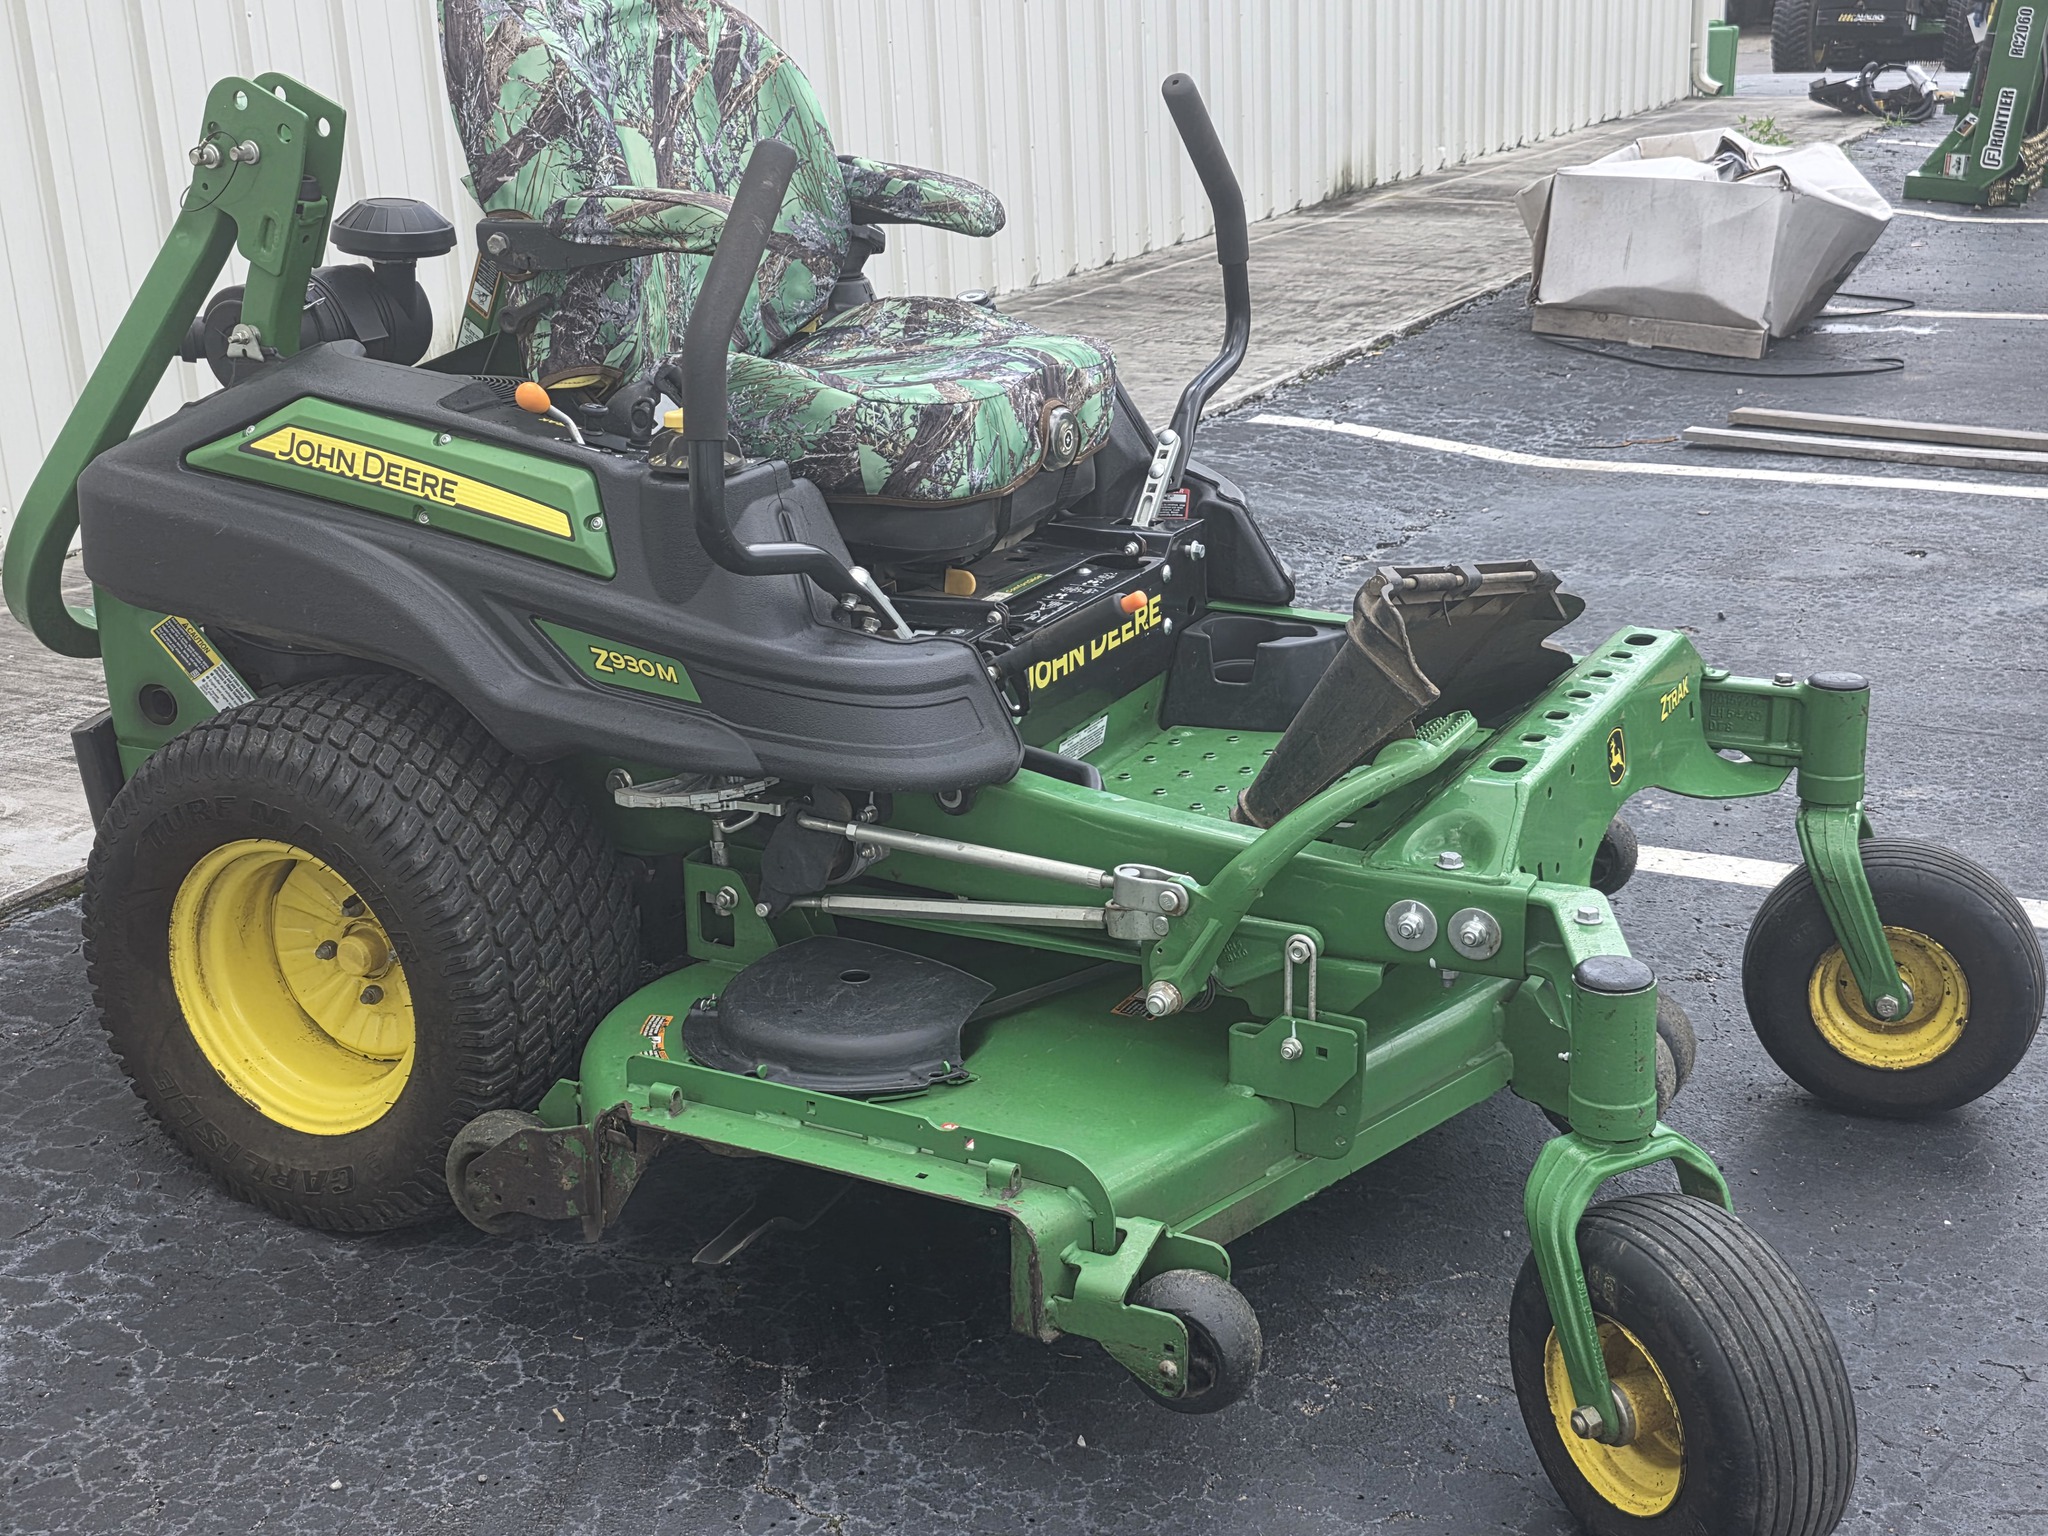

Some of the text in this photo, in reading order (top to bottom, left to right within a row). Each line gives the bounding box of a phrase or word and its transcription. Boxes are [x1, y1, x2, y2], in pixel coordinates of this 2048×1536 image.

[2010, 8, 2033, 56] RC2060
[1981, 89, 2015, 167] FRONTIER
[278, 432, 459, 502] JOHN DEERE
[187, 627, 211, 654] CAUTION
[589, 645, 679, 684] Z930M
[1659, 674, 1690, 722] ZTRAK
[153, 1068, 356, 1196] CARLISLE
